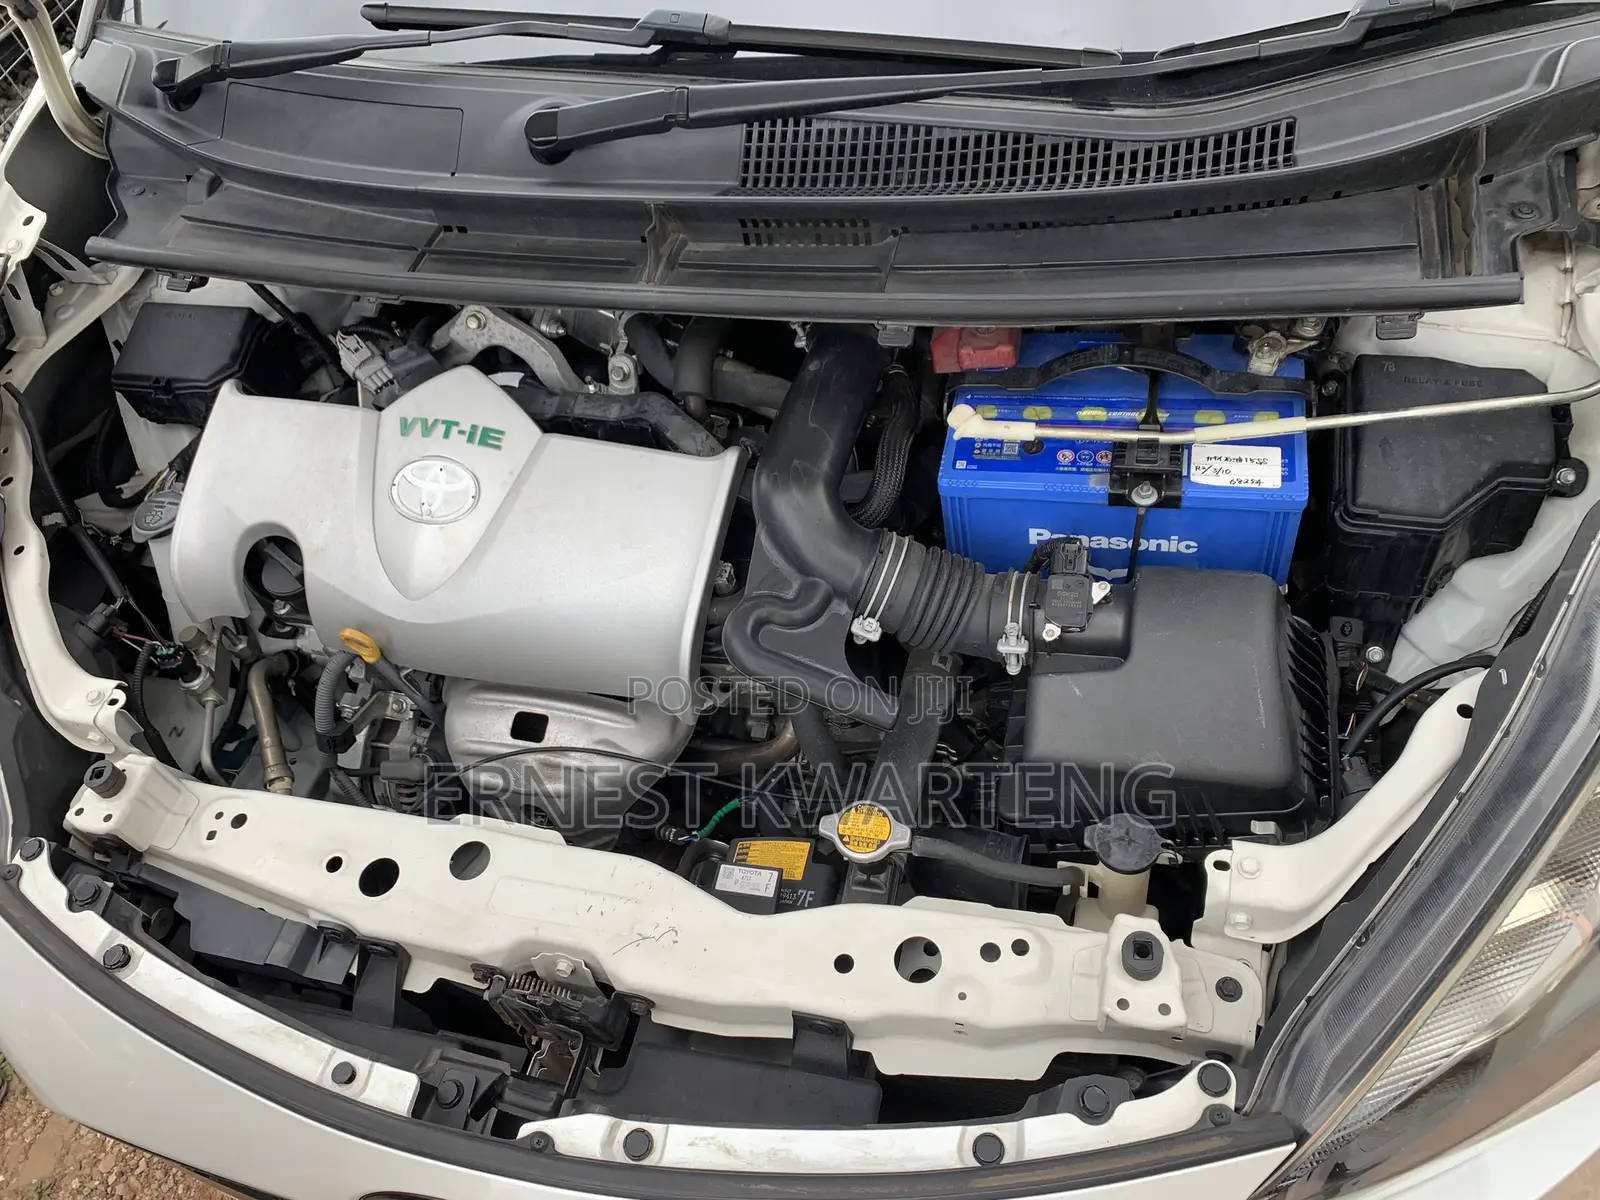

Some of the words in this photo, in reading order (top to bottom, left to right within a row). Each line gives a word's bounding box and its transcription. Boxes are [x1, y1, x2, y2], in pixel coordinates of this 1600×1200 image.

[1403, 375, 1440, 386] RELAY
[1454, 379, 1485, 388] FUSE
[738, 868, 762, 877] TOYOTA
[796, 888, 815, 908] 7F
